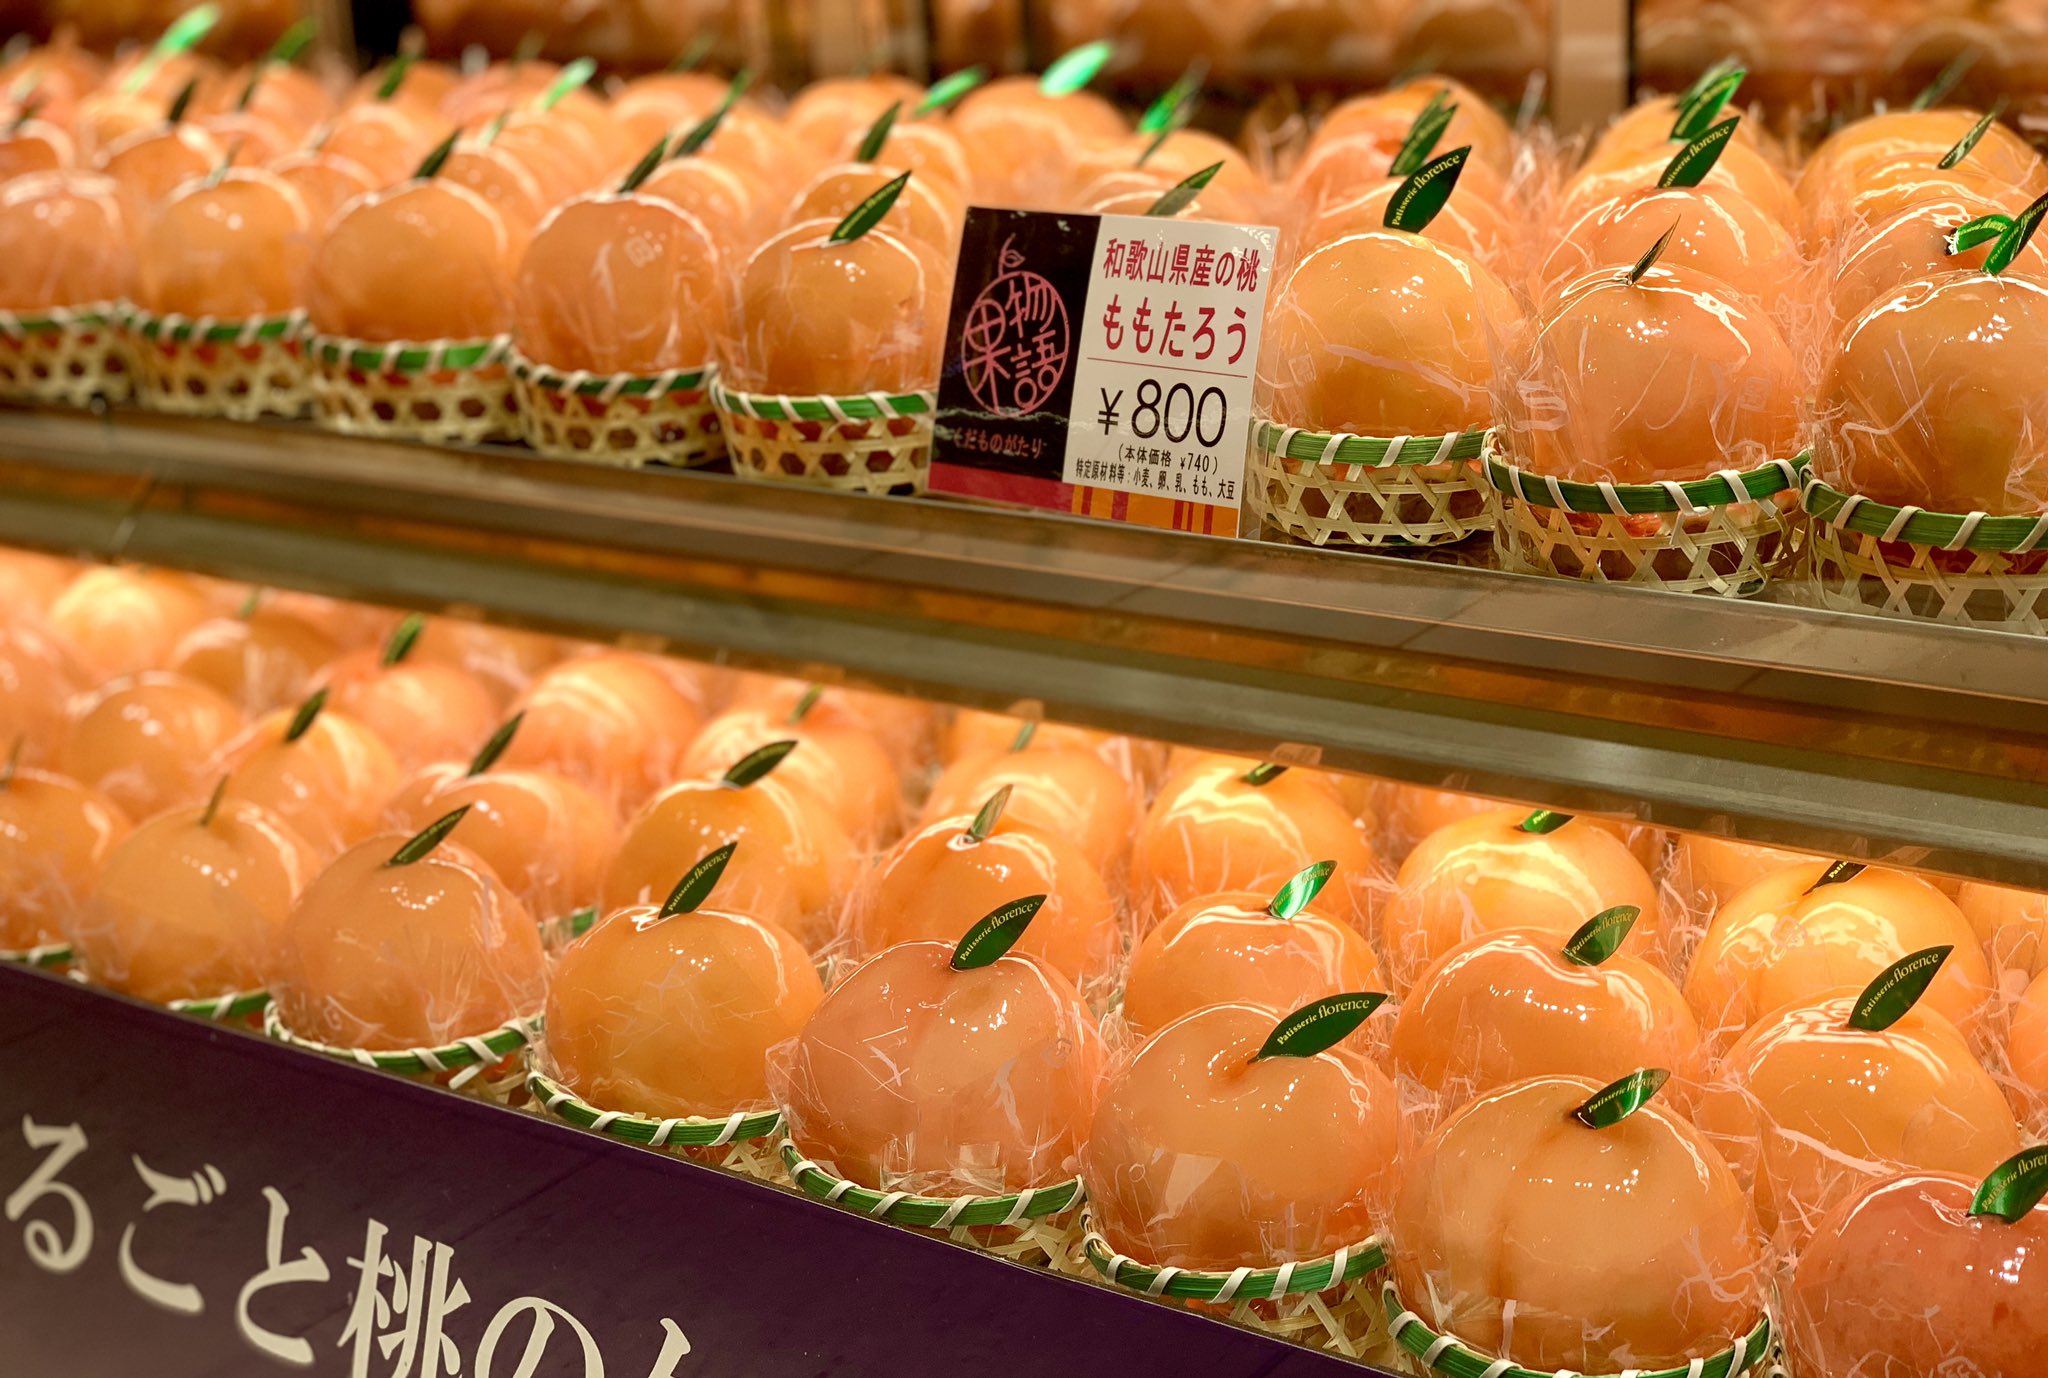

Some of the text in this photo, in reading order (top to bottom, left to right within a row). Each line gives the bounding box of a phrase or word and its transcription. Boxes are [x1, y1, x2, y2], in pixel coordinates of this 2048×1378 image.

[1689, 125, 1730, 157] florence
[1391, 187, 1417, 226] Patisserie
[1414, 153, 1460, 189] florence
[1102, 238, 1260, 292] 和歌山県産の桃
[1102, 293, 1248, 365] ももたろう
[1097, 379, 1228, 448] ¥800
[667, 850, 728, 912] Patisserie florence
[959, 902, 1034, 962] Patisserie florence
[1571, 912, 1633, 956] Patisserie florence
[1861, 953, 1939, 1020] Patisserie florence
[1276, 997, 1370, 1046] Patisserie florence
[1588, 1086, 1627, 1114] Patisserie
[1981, 1172, 2018, 1210] Patisserie
